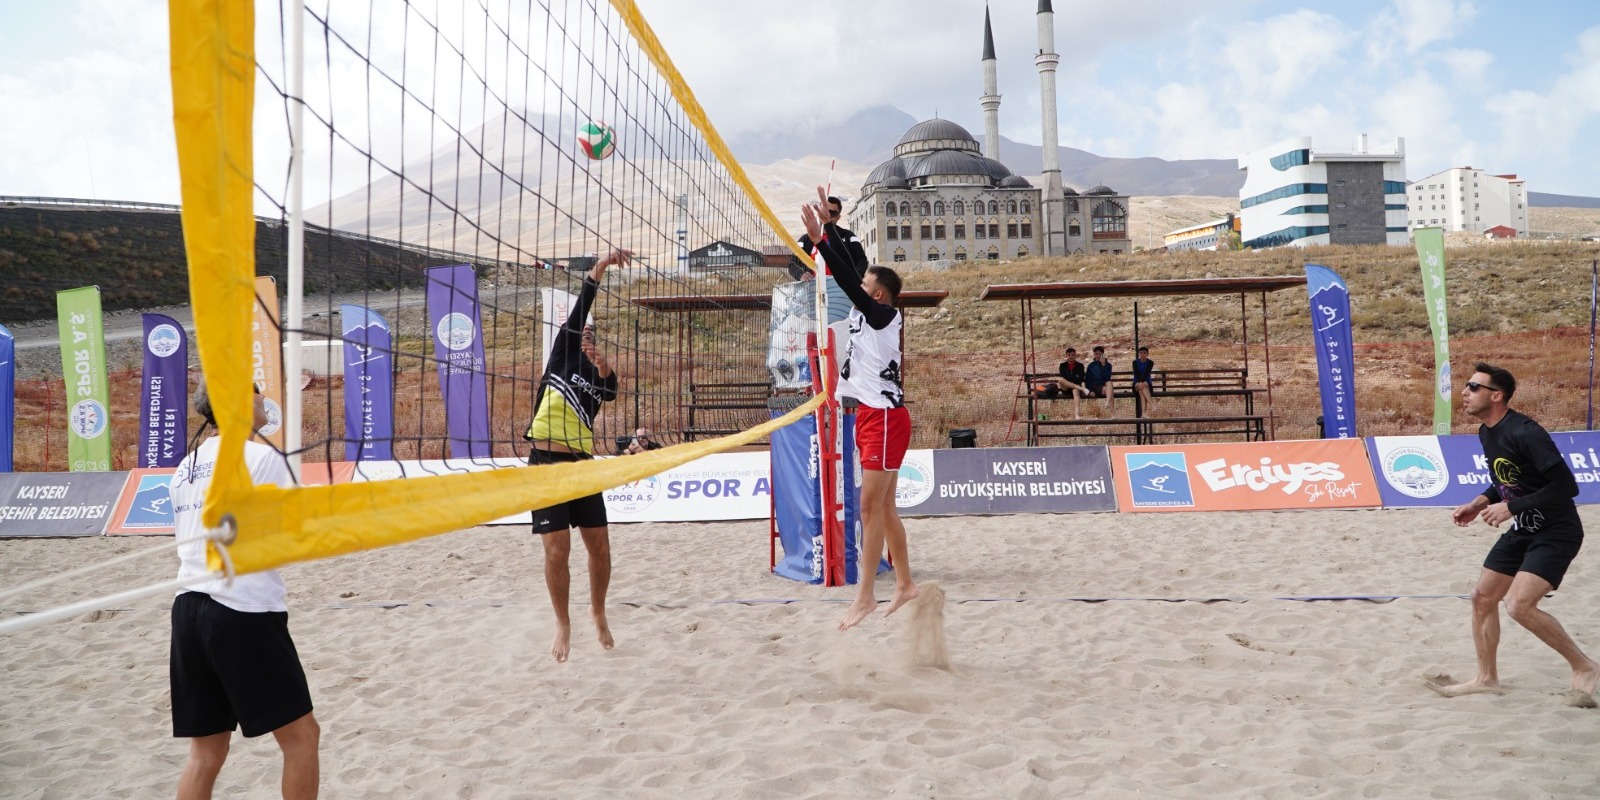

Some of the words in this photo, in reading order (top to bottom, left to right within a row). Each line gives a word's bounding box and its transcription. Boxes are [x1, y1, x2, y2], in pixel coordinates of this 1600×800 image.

[993, 457, 1047, 476] KAYSERİ
[1195, 457, 1345, 495] Erciyes
[16, 482, 71, 499] KAYSERİ
[607, 494, 633, 502] SPOR
[667, 478, 740, 500] SPOR
[940, 480, 1026, 500] BÜYÜKŞEHİR
[1030, 476, 1106, 497] BELEDİYESİ
[1304, 483, 1325, 503] Ski
[1326, 481, 1362, 499] Resort
[37, 502, 110, 520] BELEDİYESİ
